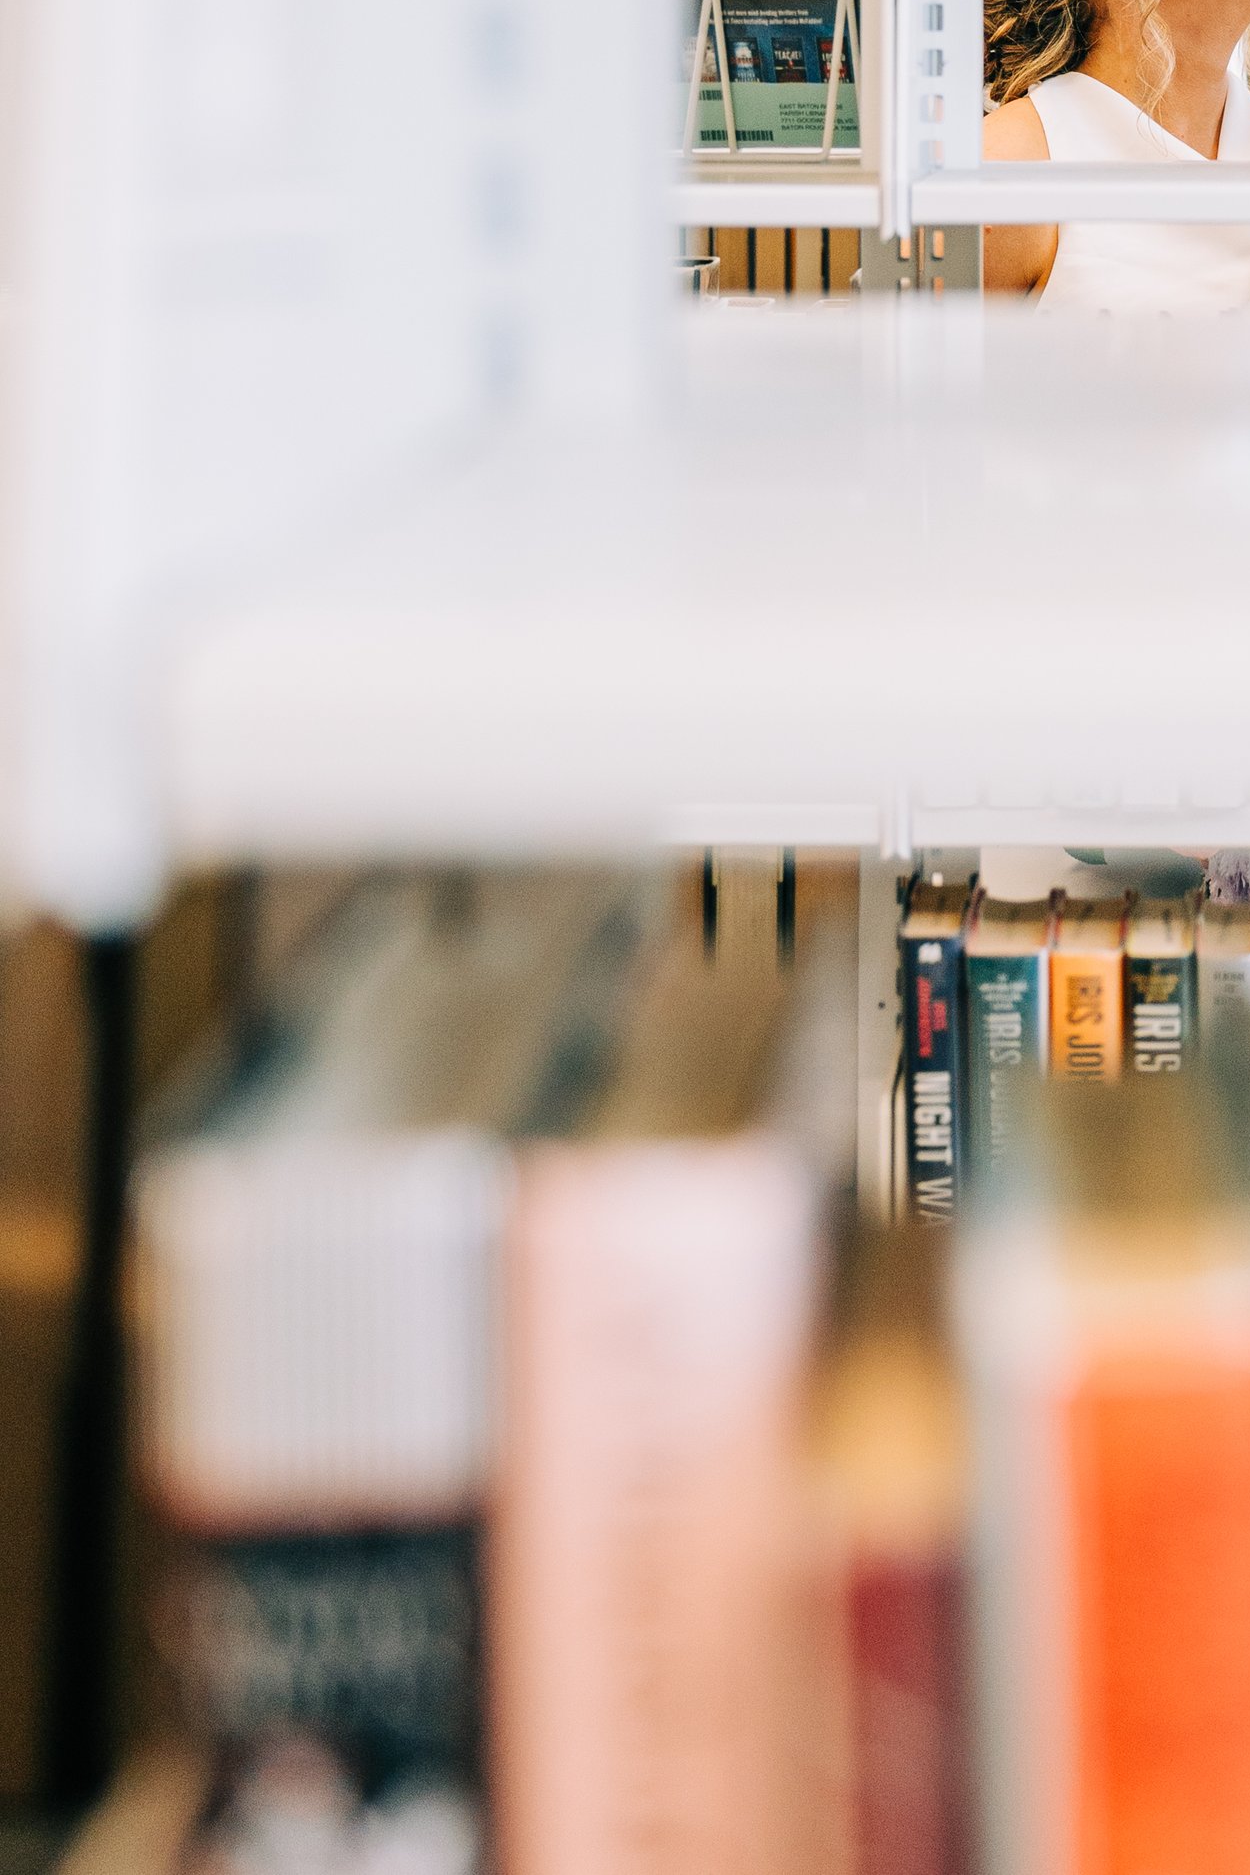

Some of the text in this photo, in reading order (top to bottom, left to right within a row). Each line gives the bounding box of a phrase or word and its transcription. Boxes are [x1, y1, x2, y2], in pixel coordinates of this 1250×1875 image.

[987, 1012, 1023, 1066] IRIS
[1133, 1003, 1182, 1072] IRIS
[914, 1070, 953, 1166] NIGHT
